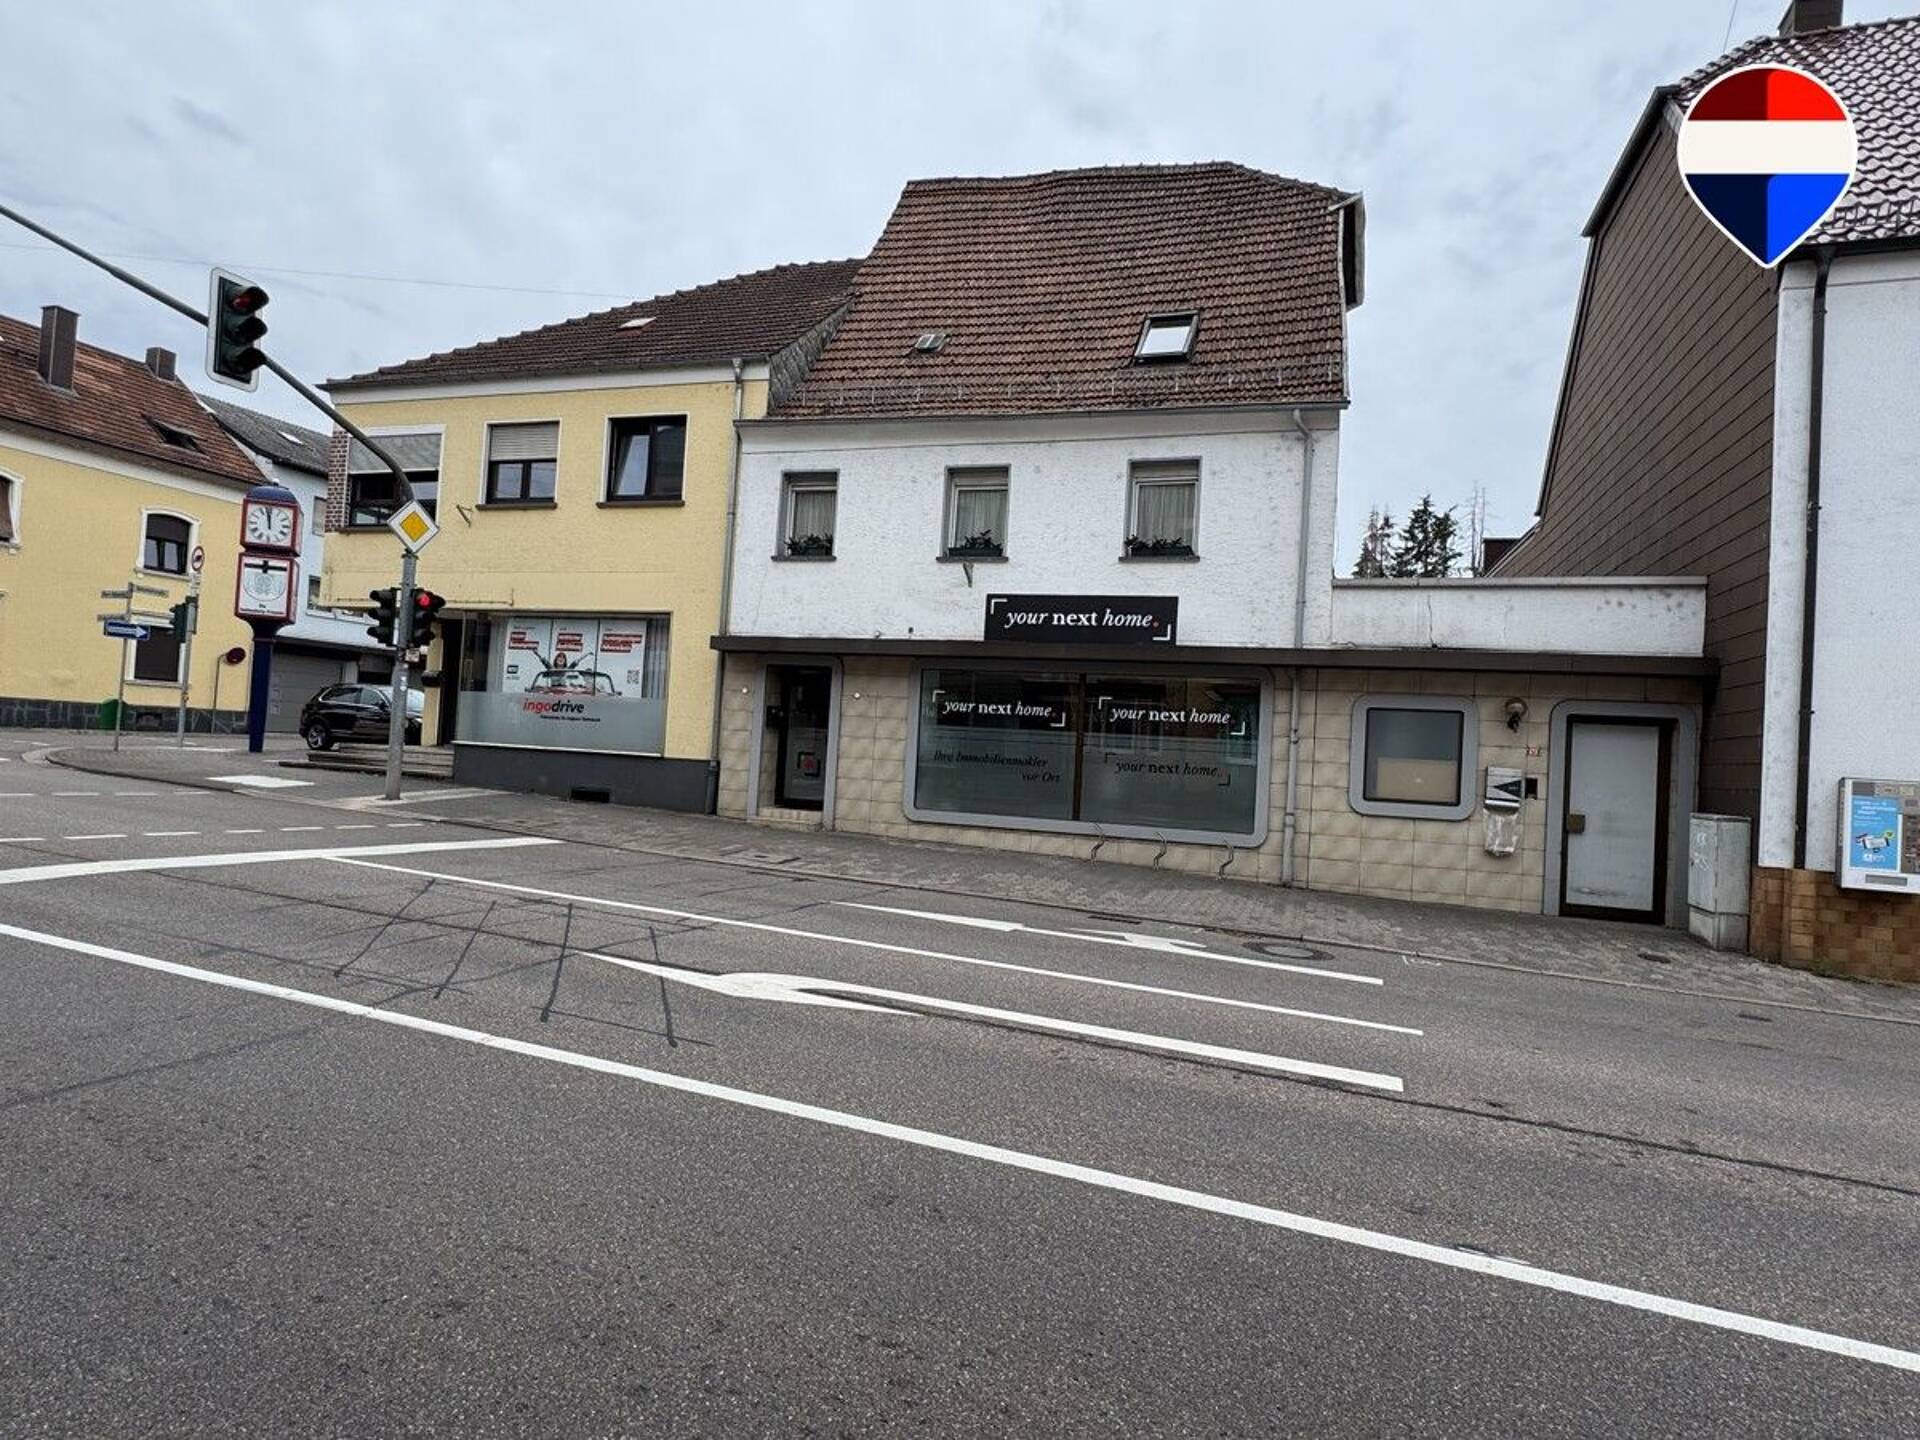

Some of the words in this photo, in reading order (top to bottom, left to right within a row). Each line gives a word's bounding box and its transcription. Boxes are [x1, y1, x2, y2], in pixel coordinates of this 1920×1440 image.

[1004, 611, 1049, 629] your
[1052, 612, 1098, 627] next
[522, 698, 585, 714] ingodrive
[942, 701, 976, 715] your
[978, 702, 1012, 716] next
[1109, 707, 1146, 723] your
[1149, 709, 1187, 723] next
[1114, 761, 1144, 775] your
[1148, 762, 1180, 776] next
